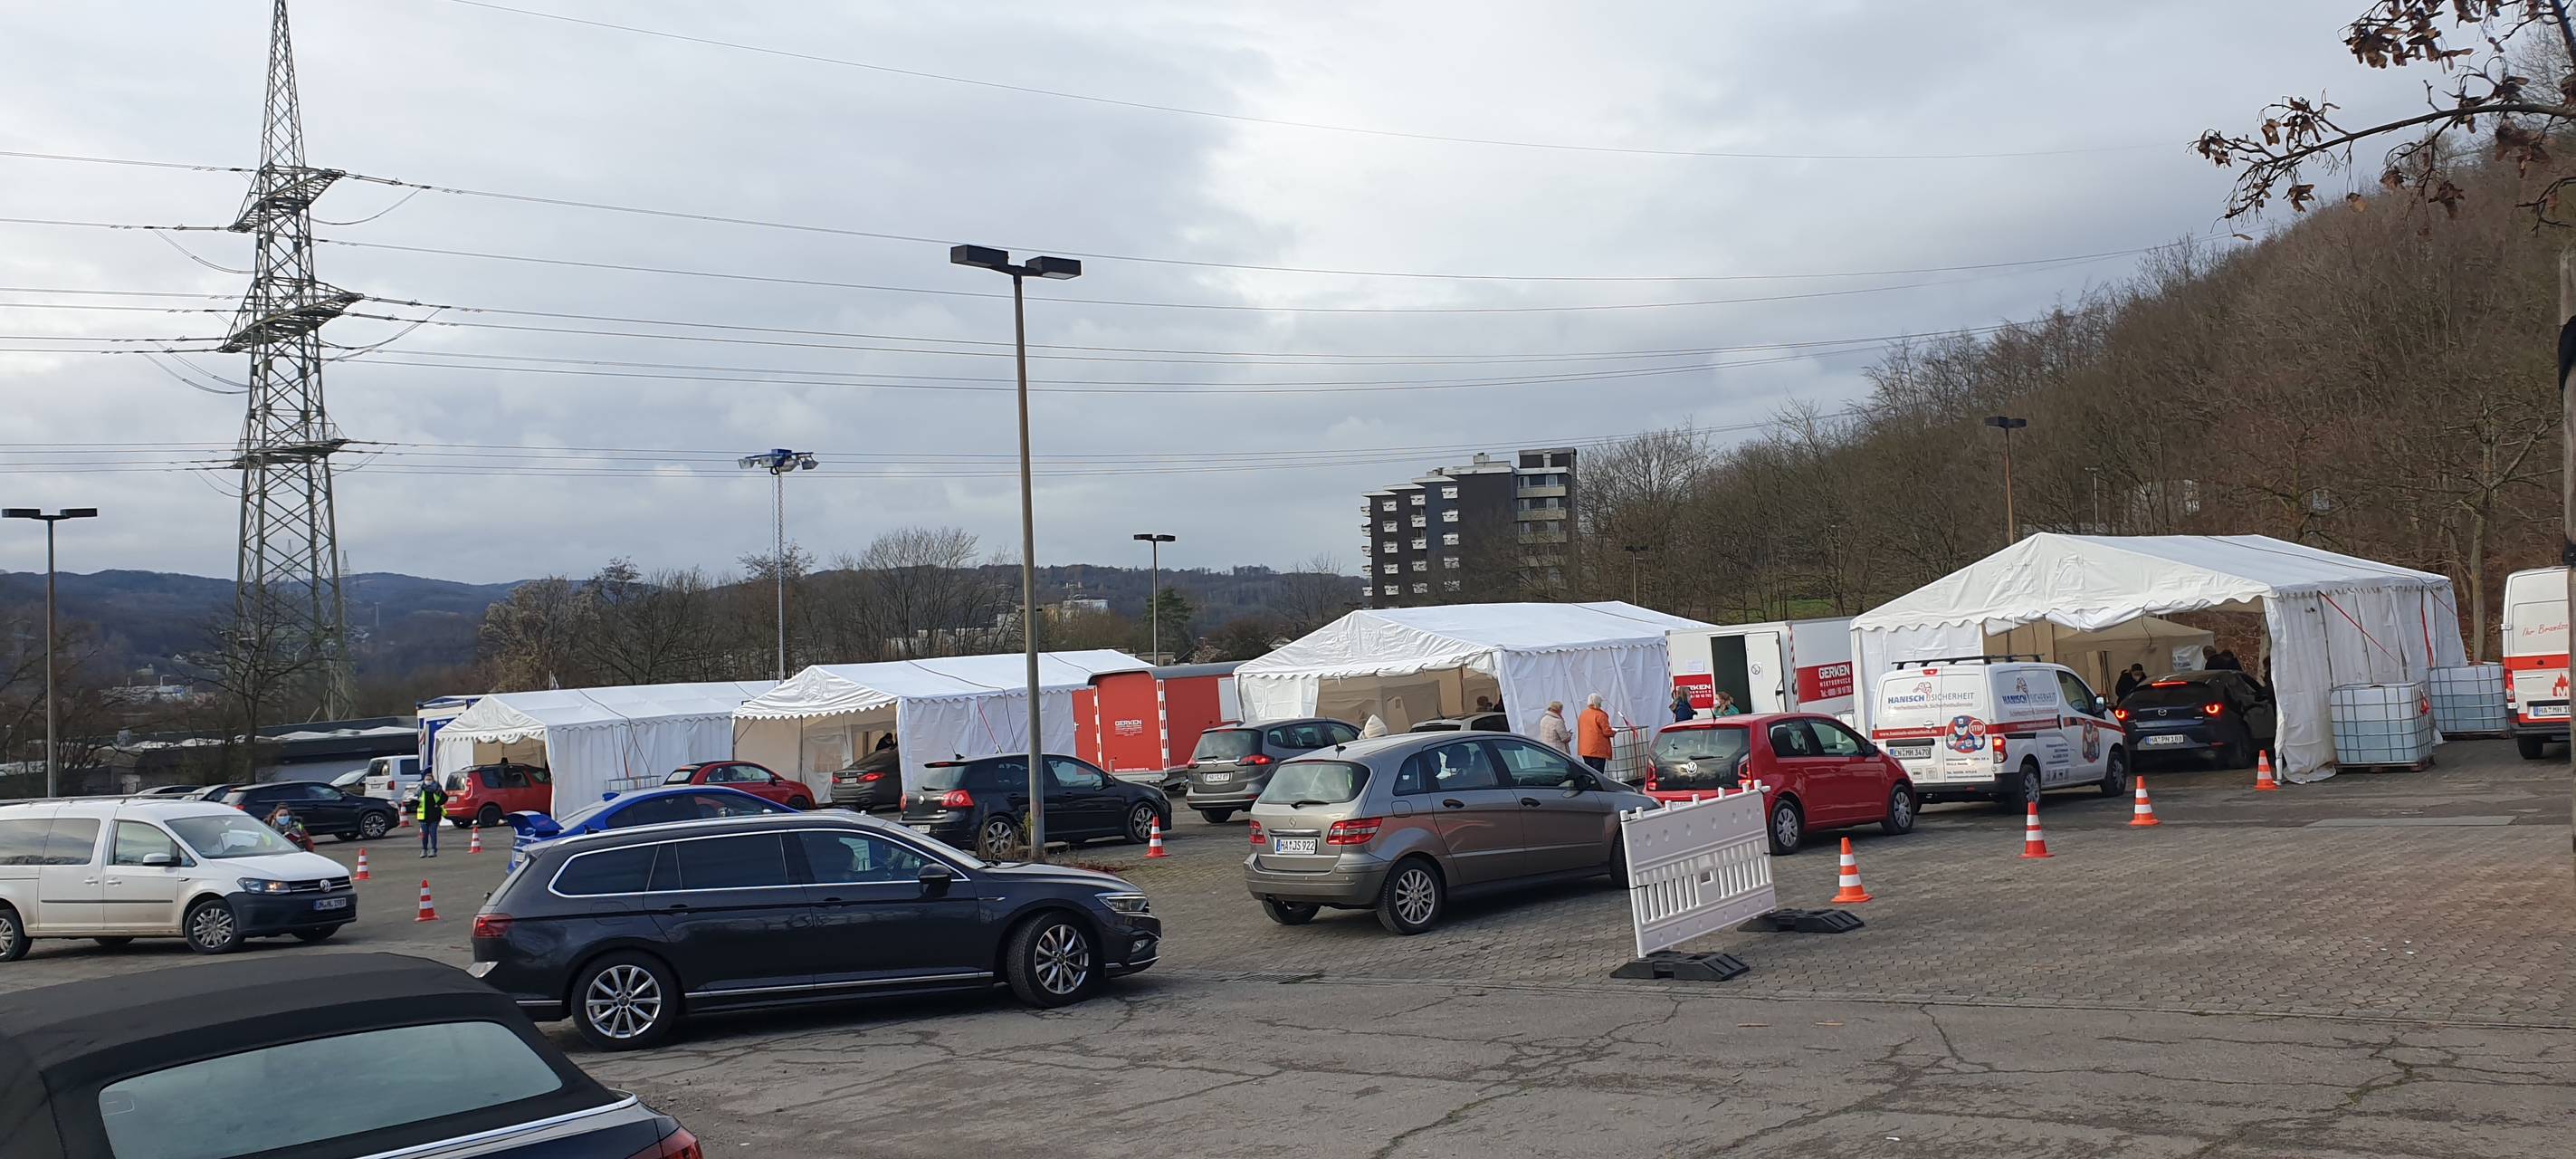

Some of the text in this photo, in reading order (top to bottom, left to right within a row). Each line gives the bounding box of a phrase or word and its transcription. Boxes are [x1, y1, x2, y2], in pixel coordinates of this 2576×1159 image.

[1818, 664, 1850, 679] GERKEN
[1887, 692, 1974, 704] HANISCH SICHERHEIT
[1281, 841, 1314, 850] HA JS 922
